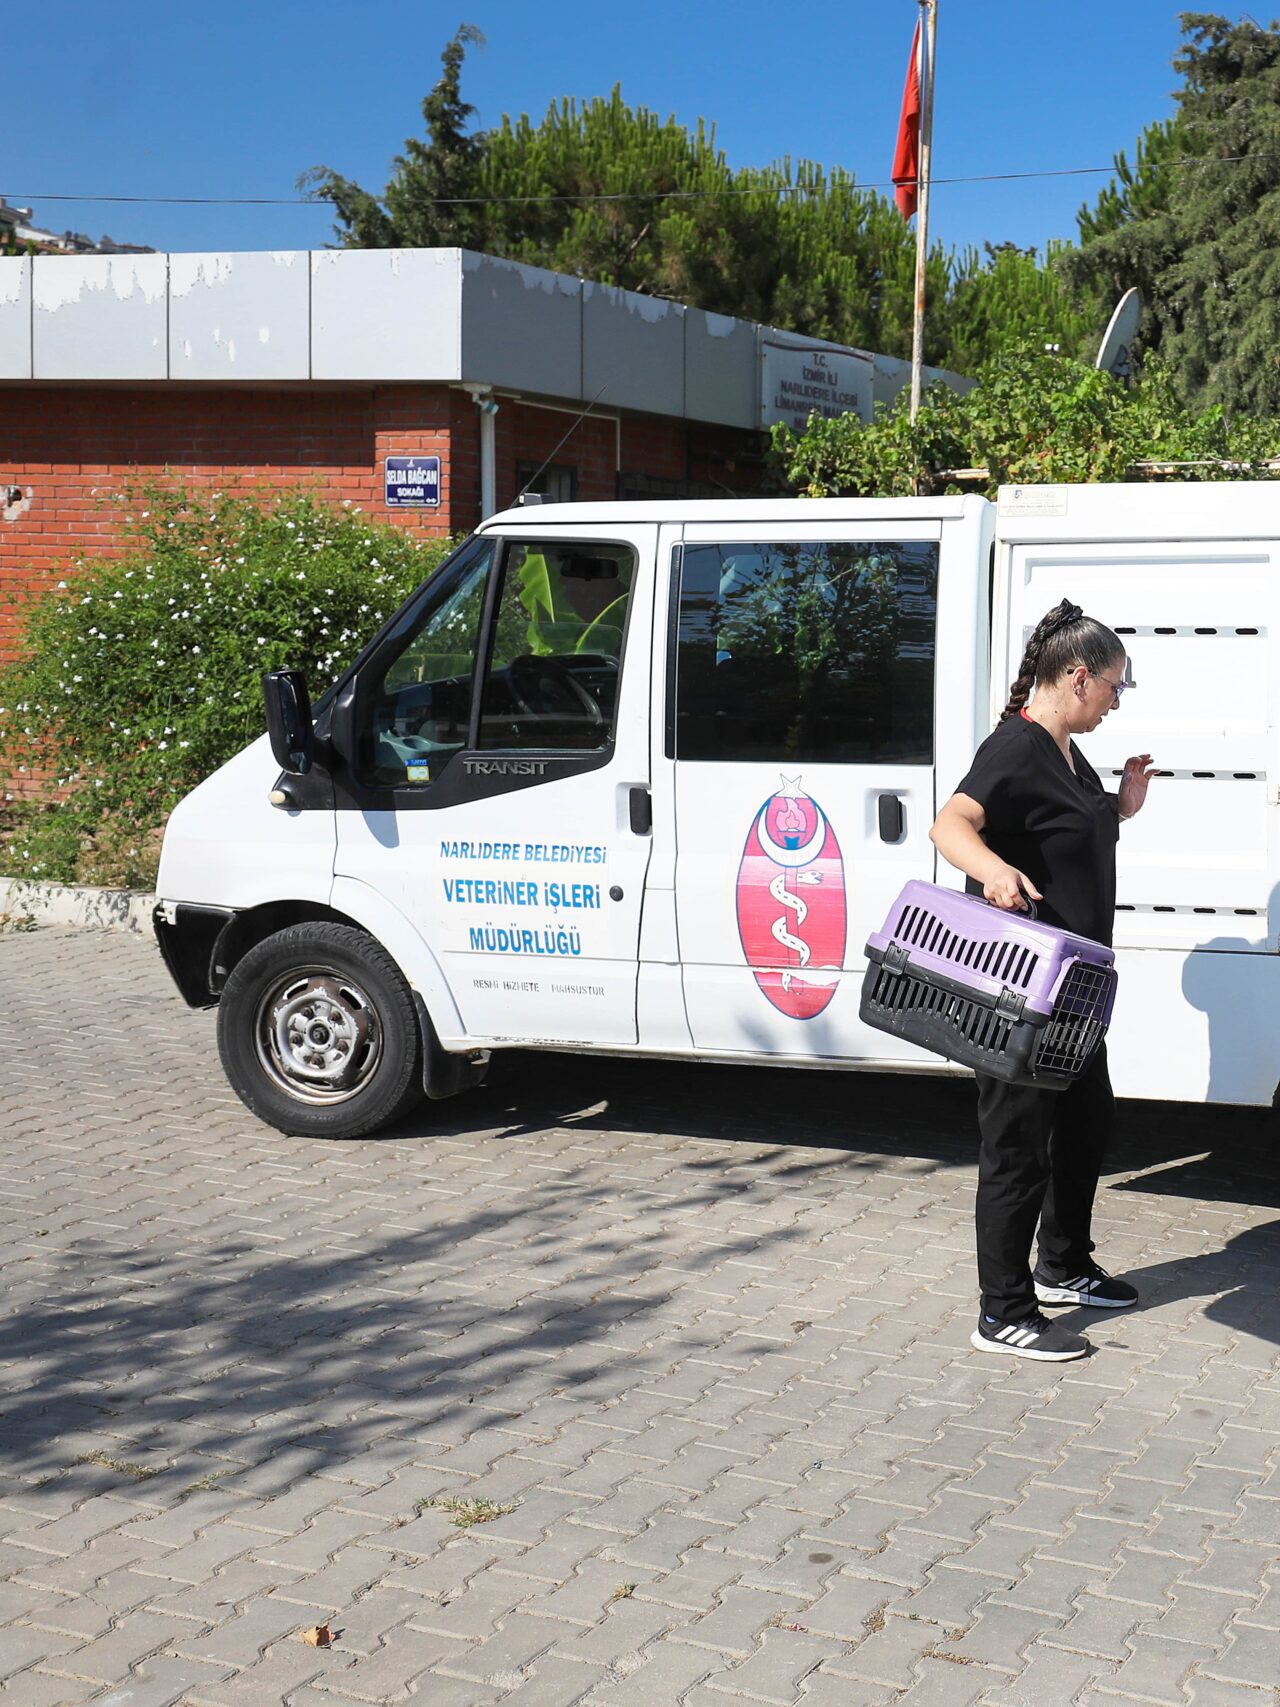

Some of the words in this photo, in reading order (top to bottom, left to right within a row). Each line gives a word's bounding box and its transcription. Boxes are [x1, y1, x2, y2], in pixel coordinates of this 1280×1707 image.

[813, 353, 828, 367] T.C.
[803, 365, 826, 383] İZMİR
[828, 370, 838, 386] İLİ
[781, 380, 829, 400] NARLIDERE
[832, 388, 857, 406] İLÇESİ
[387, 470, 406, 485] SELDA
[408, 467, 436, 485] BAĞCAN
[397, 486, 424, 496] SOKAĞI
[463, 761, 549, 775] TRANSIT
[440, 841, 520, 861] NARLIDERE
[524, 843, 607, 864] BELEDİYESİ
[442, 878, 539, 906] VETERİNER
[544, 881, 601, 914] İŞLERİ
[469, 921, 581, 956] MÜDÜRLÜĞÜ
